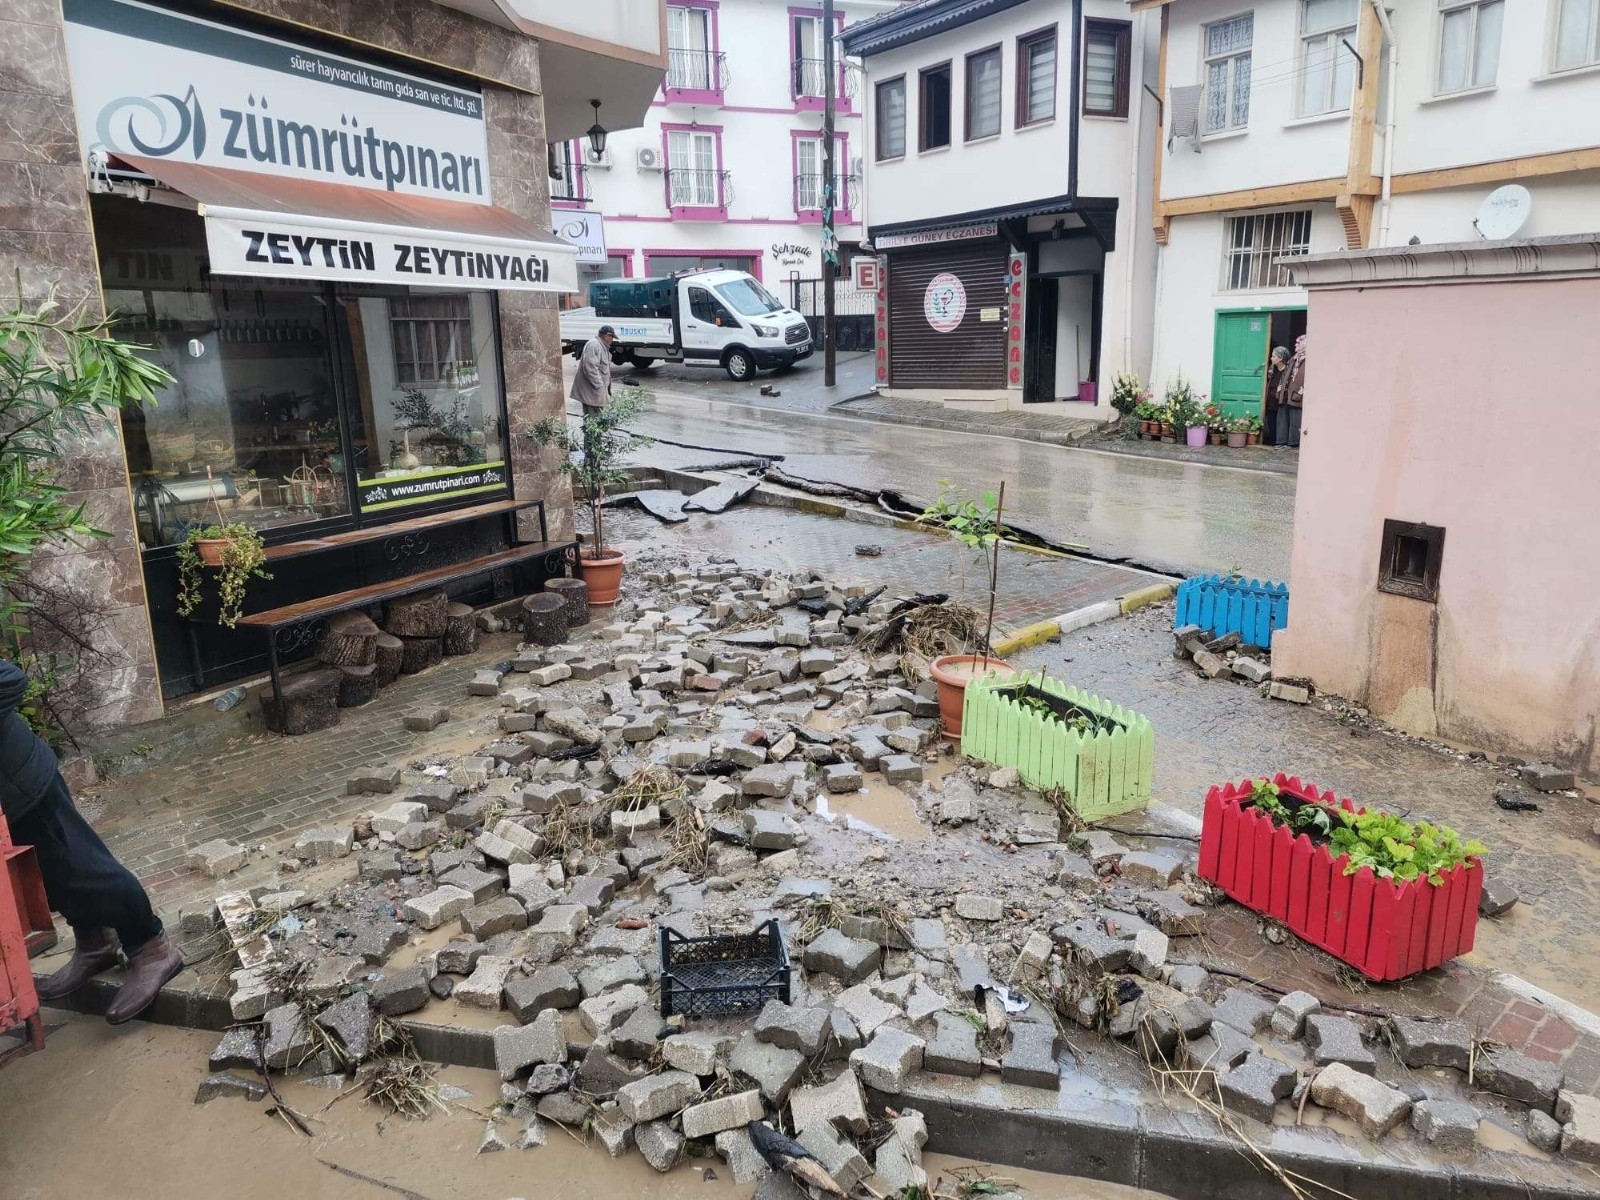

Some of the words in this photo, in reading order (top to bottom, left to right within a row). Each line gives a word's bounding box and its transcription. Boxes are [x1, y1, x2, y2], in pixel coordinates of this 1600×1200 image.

[290, 54, 315, 72] sürer
[317, 60, 370, 86] hayvancılık
[370, 75, 394, 92] tarım
[395, 82, 414, 98] gıda
[430, 92, 440, 104] ve
[440, 93, 453, 108] tic.
[453, 94, 466, 111] ltd.
[466, 99, 478, 115] şti.
[219, 92, 483, 196] zümrütpınarı
[911, 231, 943, 244] GÜNEY
[860, 266, 874, 286] E
[391, 474, 480, 496] www.zumrutpinari.com
